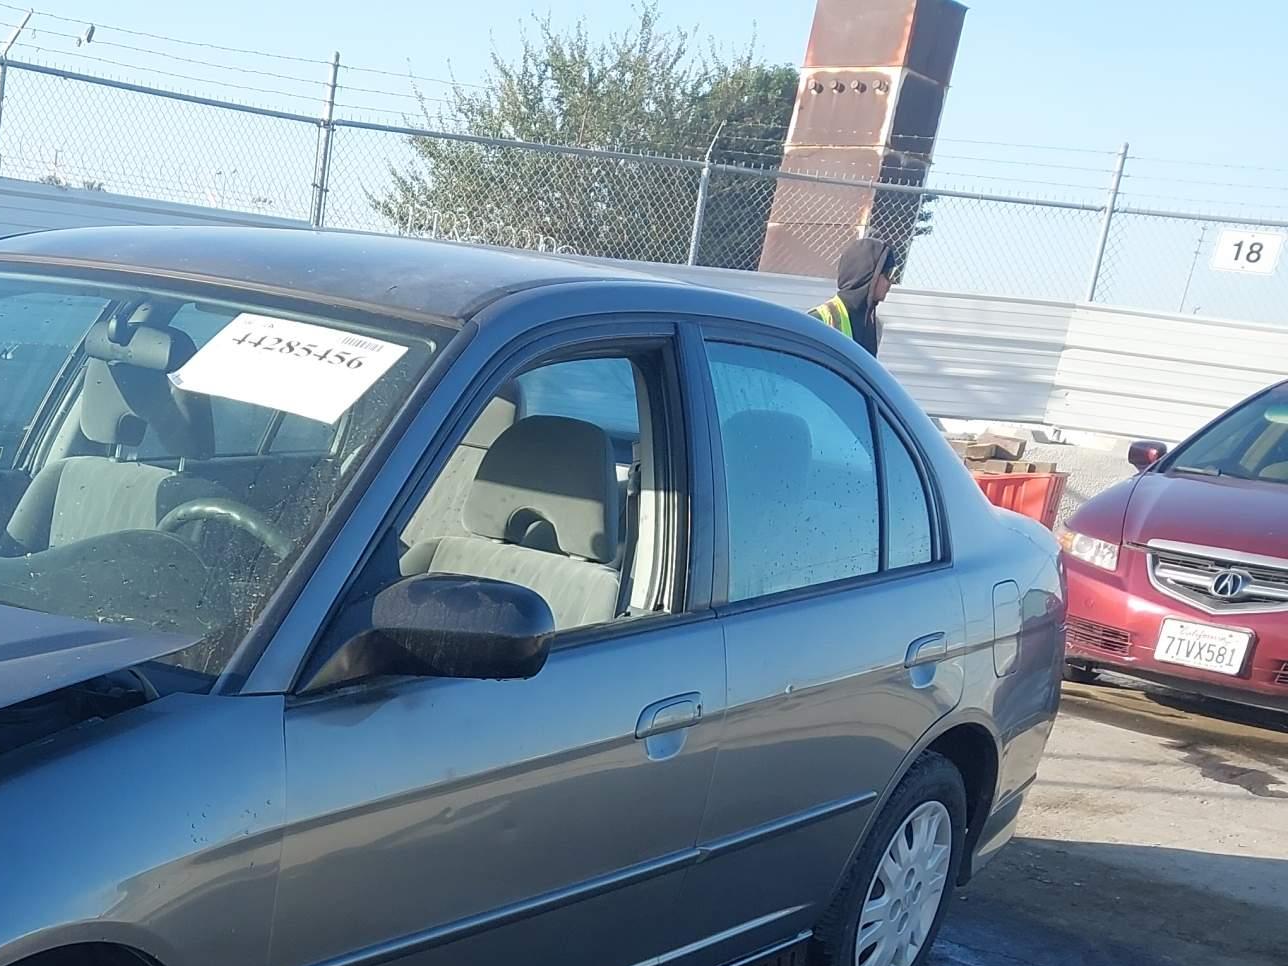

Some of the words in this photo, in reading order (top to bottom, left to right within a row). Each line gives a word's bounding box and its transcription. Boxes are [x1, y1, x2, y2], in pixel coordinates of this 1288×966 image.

[1233, 240, 1264, 263] 18
[231, 332, 367, 370] 44285456
[1165, 635, 1237, 667] 7TVX581
